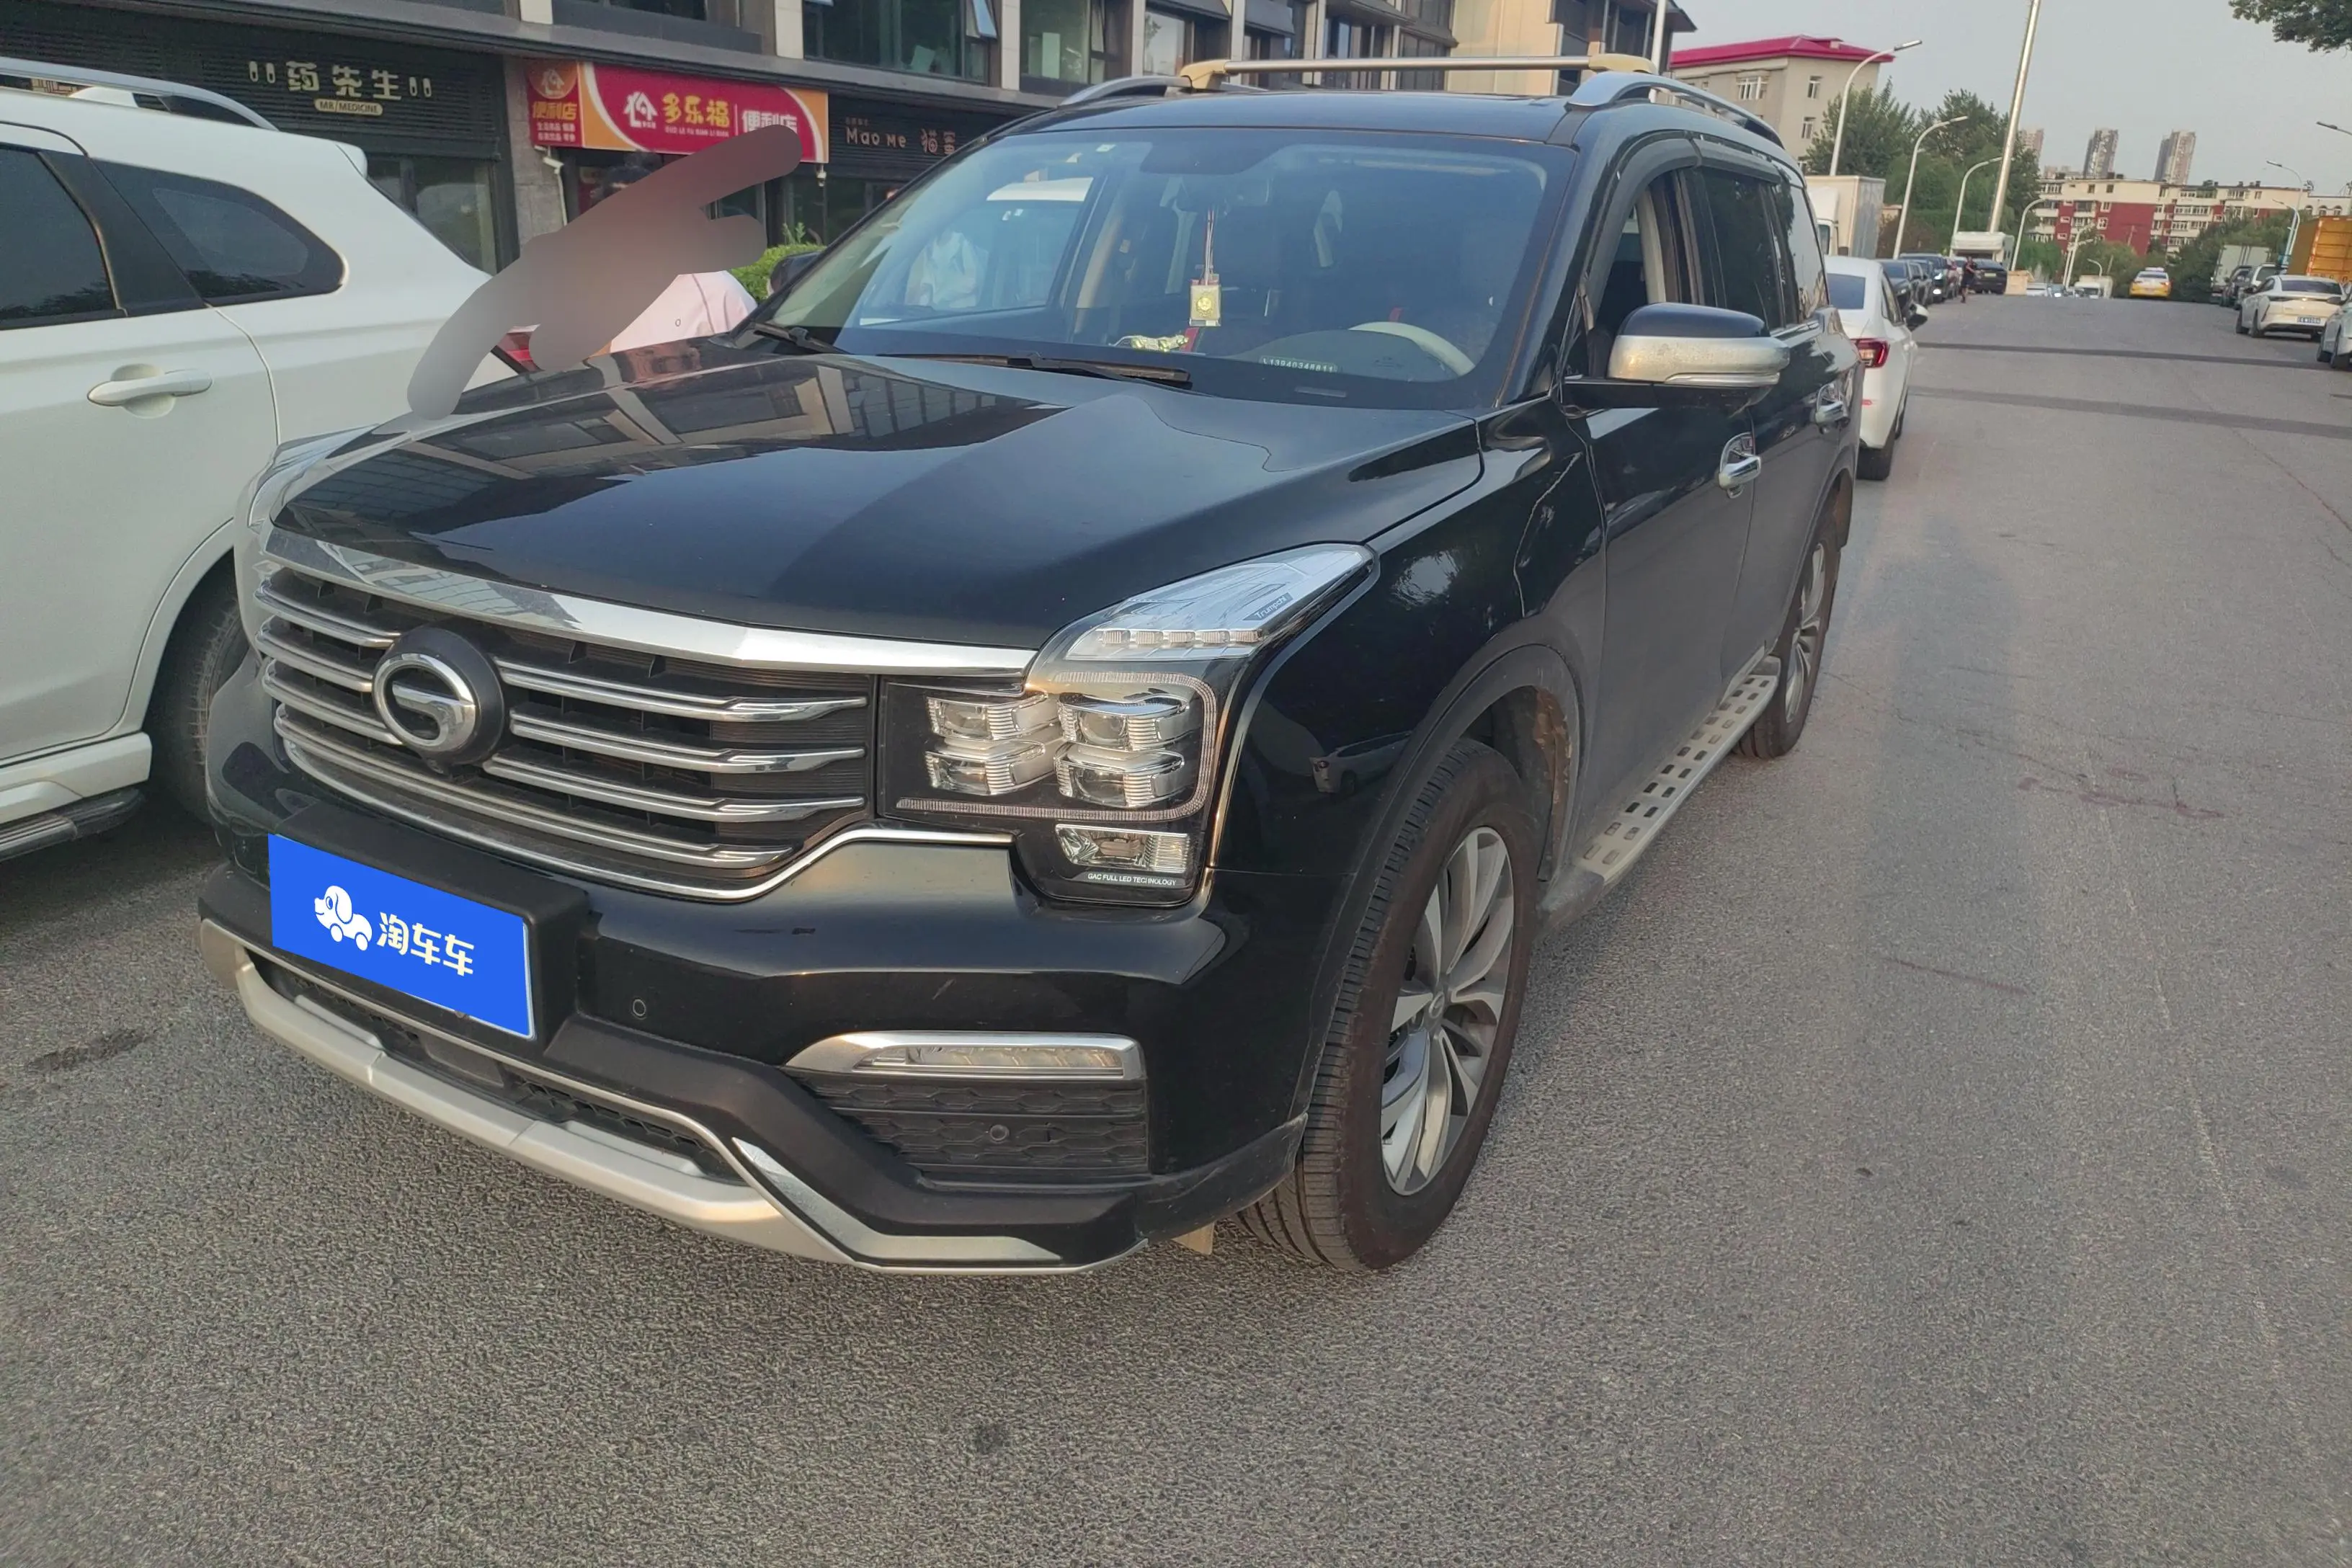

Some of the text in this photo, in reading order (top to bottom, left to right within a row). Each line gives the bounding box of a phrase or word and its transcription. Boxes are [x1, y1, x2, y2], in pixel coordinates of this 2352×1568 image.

[286, 61, 402, 101] 药先生
[532, 101, 578, 121] 便利店
[662, 92, 730, 128] 多乐福
[847, 126, 881, 146] Mao
[1254, 595, 1287, 619] Trumpchi
[1133, 876, 1177, 886] TECHNOLOGY
